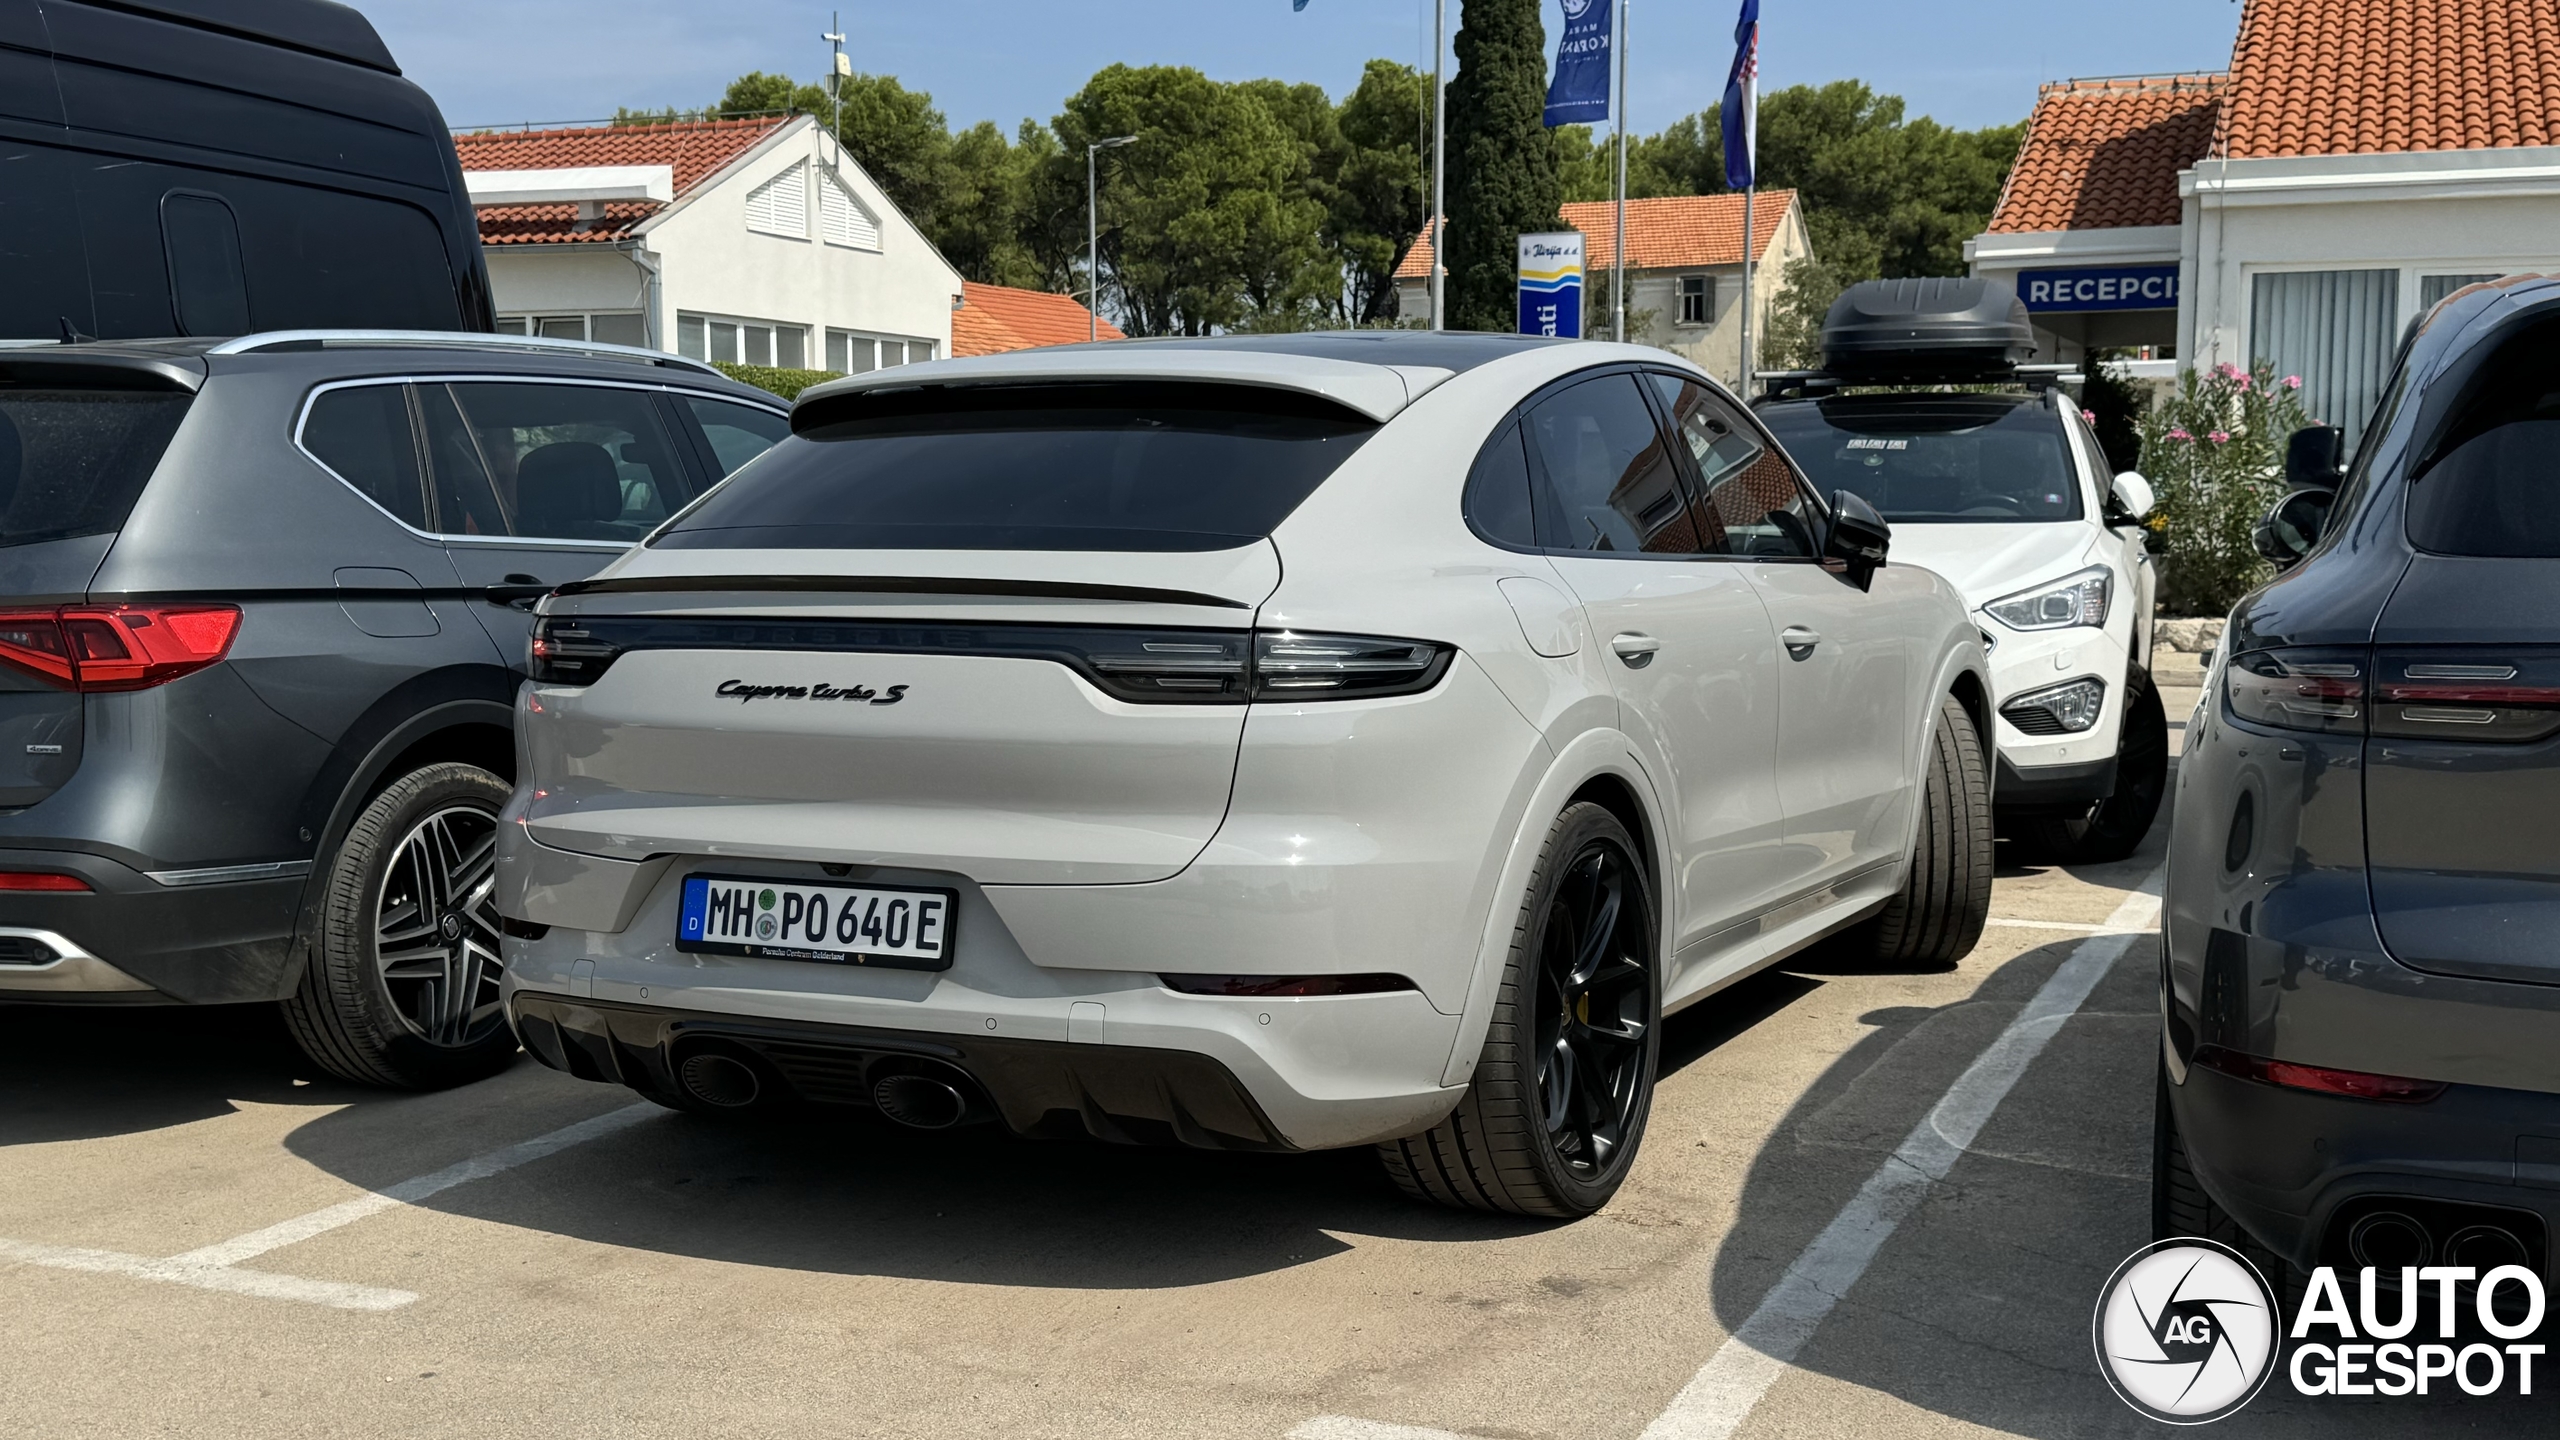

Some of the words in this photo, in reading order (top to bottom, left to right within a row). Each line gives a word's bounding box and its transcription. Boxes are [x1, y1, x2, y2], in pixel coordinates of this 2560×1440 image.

[2029, 276, 2179, 303] RECEPCI
[716, 679, 808, 705] Cayenne
[810, 683, 876, 701] turbo
[870, 685, 910, 704] S
[688, 917, 698, 931] D
[707, 887, 756, 937] MH
[781, 892, 829, 943] PO
